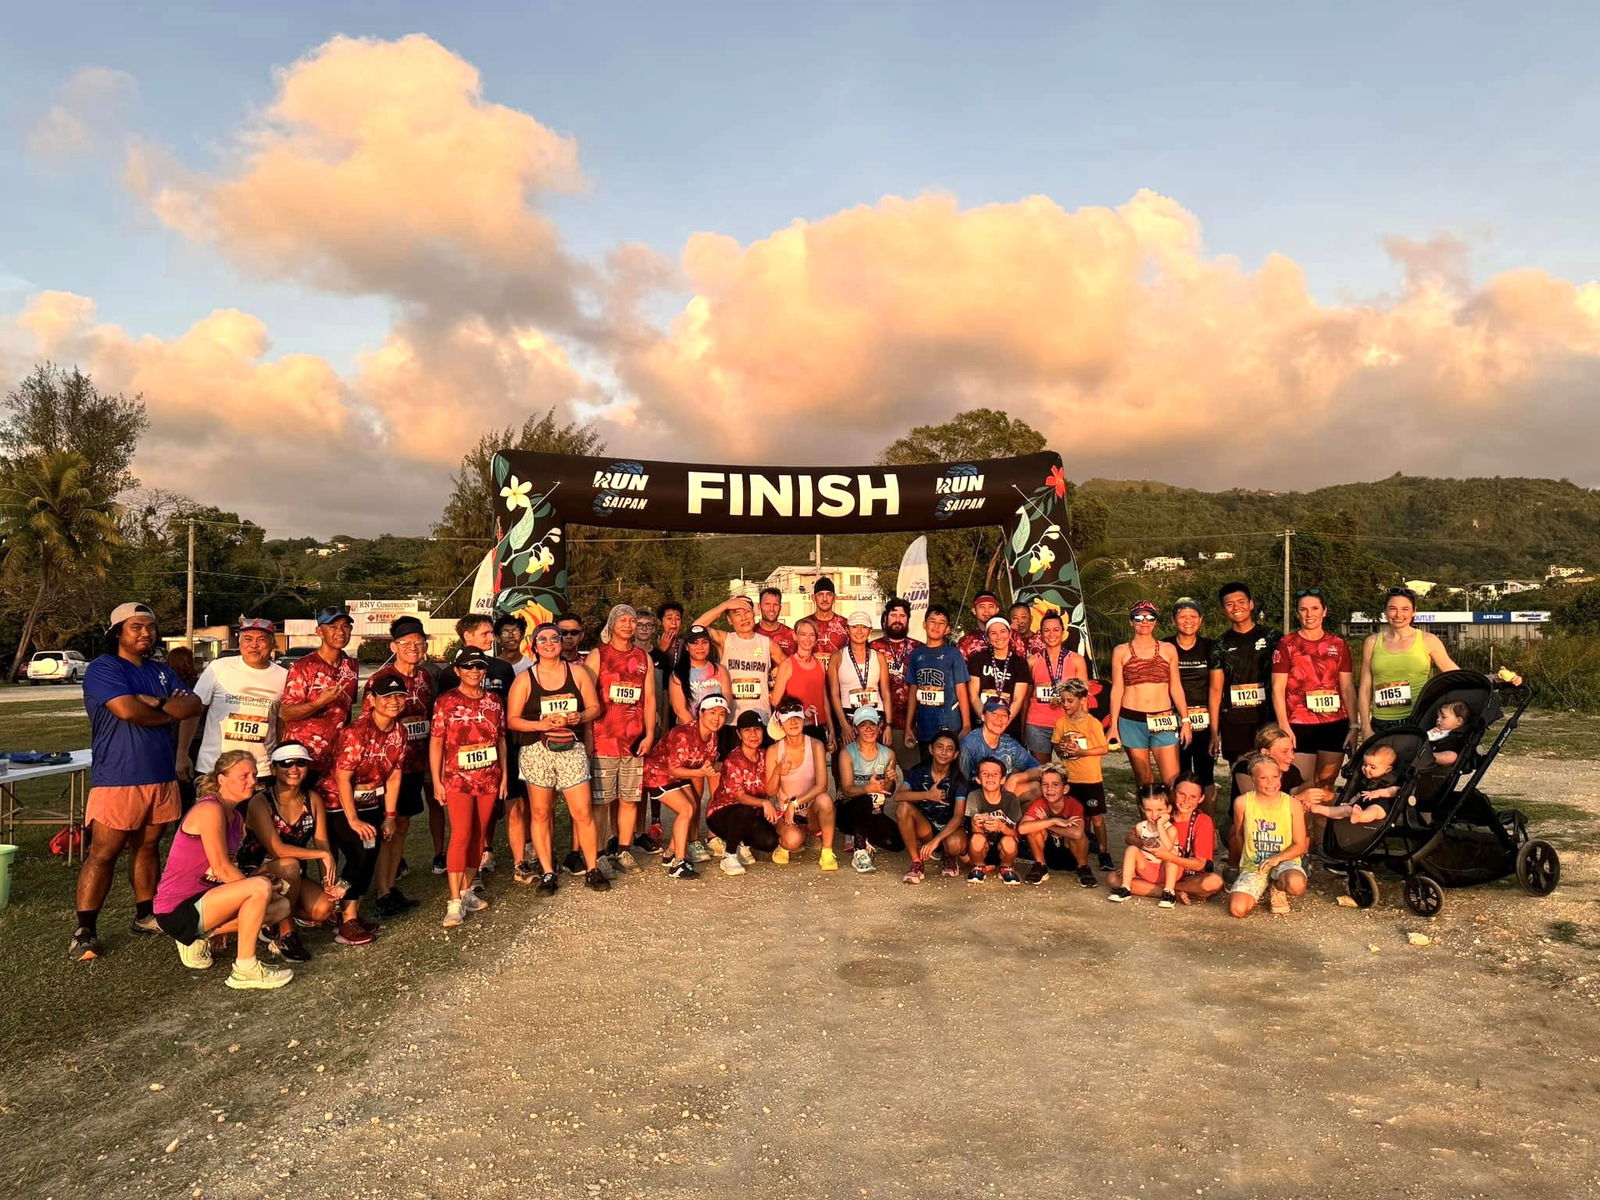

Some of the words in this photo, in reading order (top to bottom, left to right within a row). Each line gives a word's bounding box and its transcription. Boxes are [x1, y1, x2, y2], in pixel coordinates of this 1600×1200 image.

[592, 470, 650, 491] RUN
[935, 474, 985, 494] RUN
[688, 471, 900, 517] FINISH
[602, 495, 649, 510] SAIPAN
[944, 497, 986, 511] SAIPAN
[741, 660, 766, 672] SAIPAN
[616, 688, 634, 699] 1159
[921, 691, 936, 701] 1197
[1237, 690, 1258, 701] 1120
[1380, 687, 1402, 700] 1165
[549, 701, 569, 711] 1112
[234, 721, 259, 734] 1158
[466, 750, 488, 763] 1161
